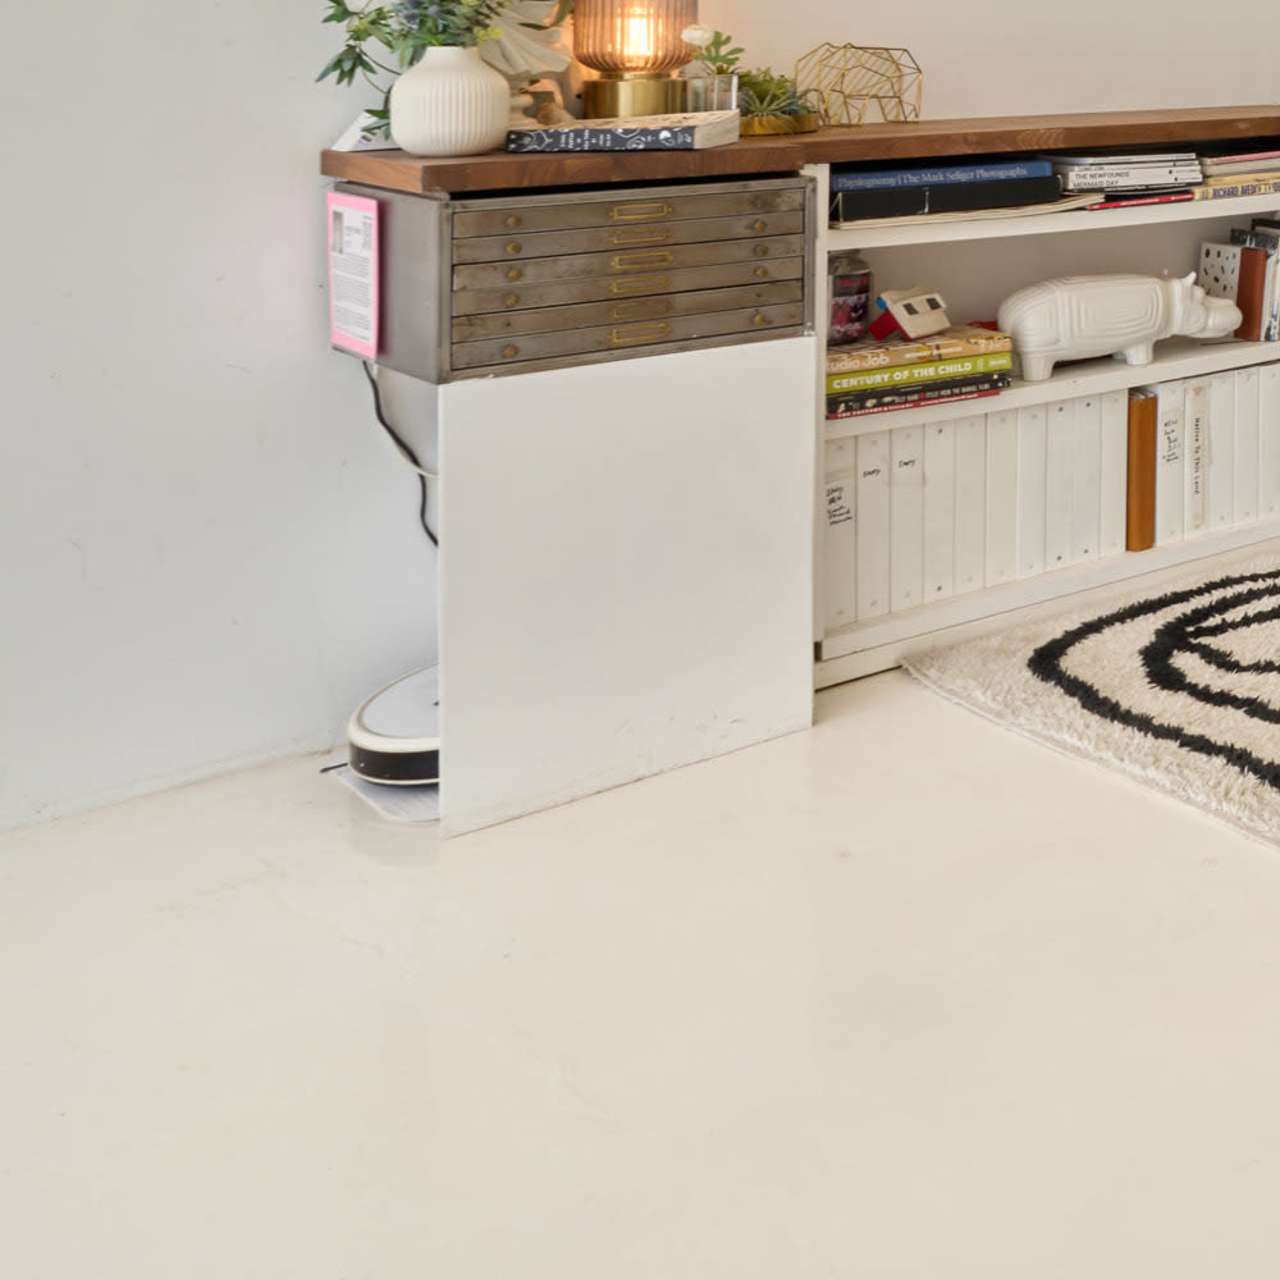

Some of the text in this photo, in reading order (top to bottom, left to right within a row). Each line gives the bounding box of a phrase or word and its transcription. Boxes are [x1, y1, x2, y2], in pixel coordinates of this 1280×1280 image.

[832, 363, 973, 388] CENTURY OF THE CHILD
